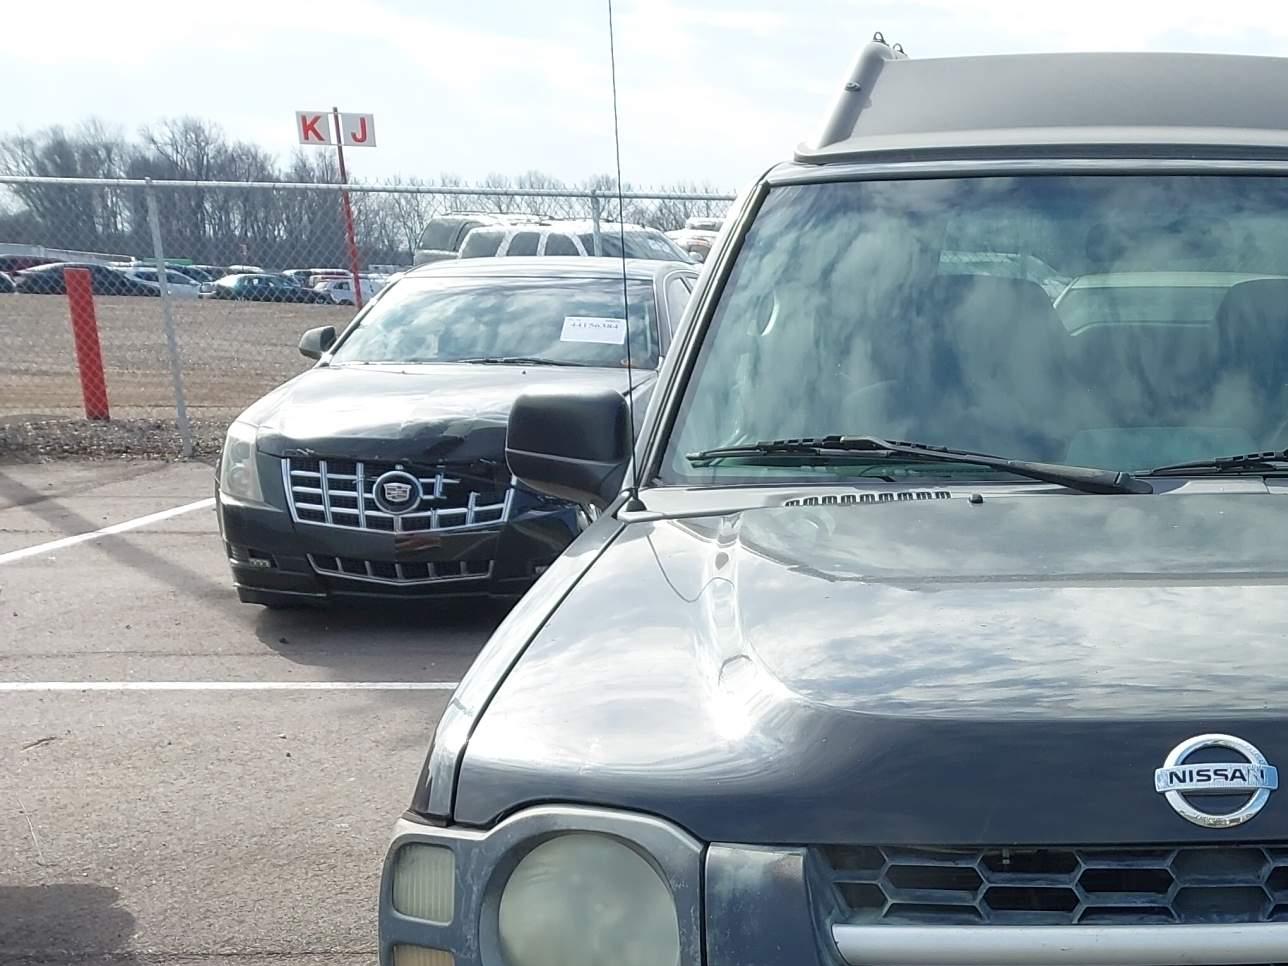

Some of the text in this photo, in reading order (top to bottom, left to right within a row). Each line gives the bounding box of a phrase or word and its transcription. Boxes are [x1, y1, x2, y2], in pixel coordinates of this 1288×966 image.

[301, 115, 325, 141] K
[351, 117, 367, 143] J
[1169, 768, 1265, 785] NISSAN
